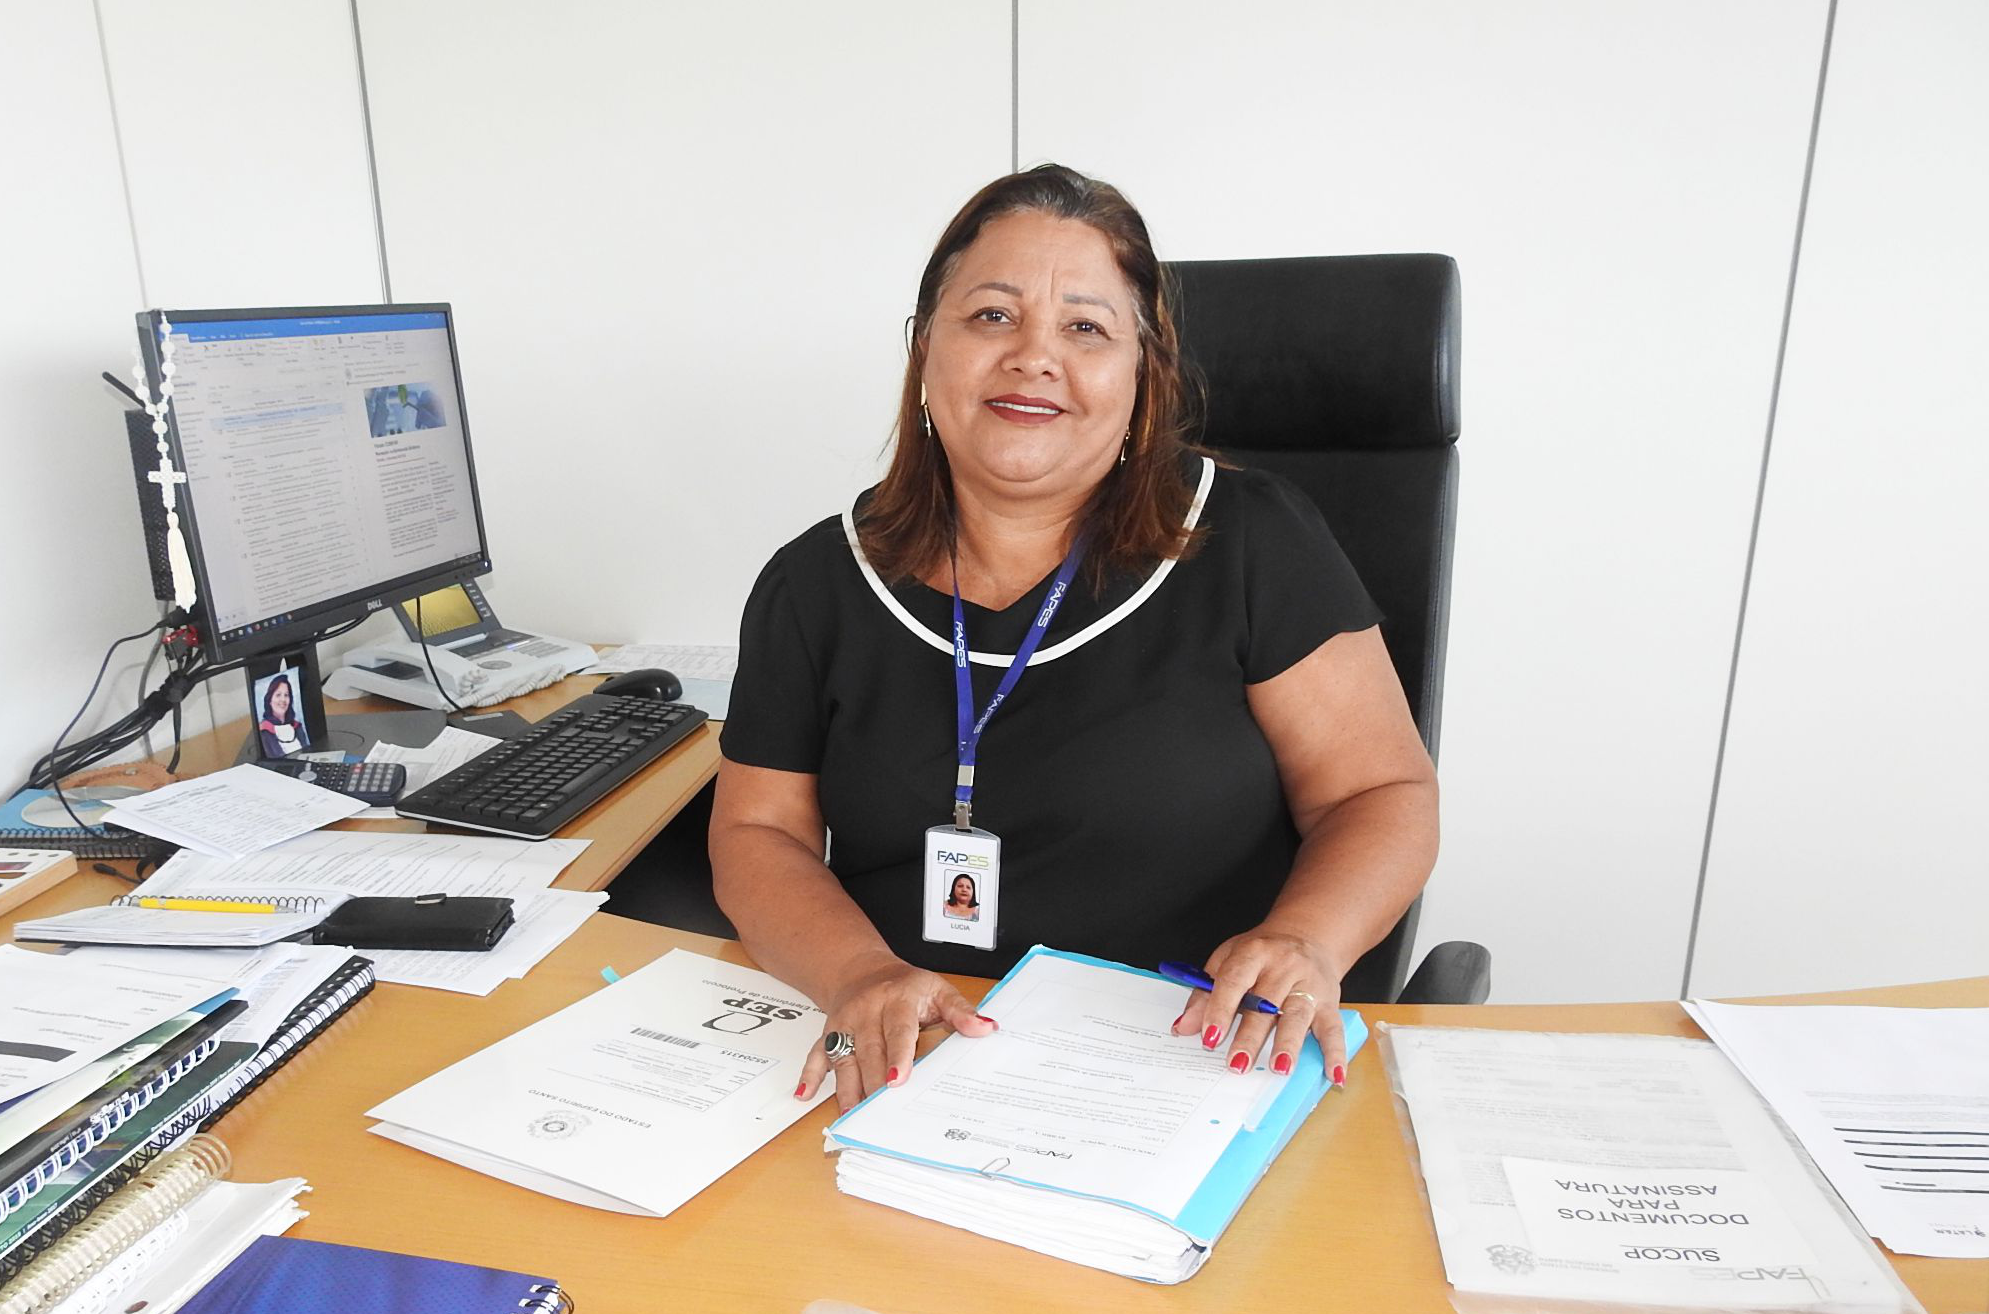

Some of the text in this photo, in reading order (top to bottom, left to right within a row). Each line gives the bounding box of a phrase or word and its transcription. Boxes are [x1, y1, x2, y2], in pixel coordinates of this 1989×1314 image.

[1038, 581, 1067, 628] FAPES
[956, 621, 967, 668] FAPES
[973, 693, 1005, 734] FAPES
[937, 850, 990, 868] FAPES
[722, 997, 803, 1021] SEP
[1014, 1143, 1072, 1160] FAPES
[1554, 1179, 1718, 1197] ASSINATURA
[1606, 1197, 1681, 1210] PARA
[1557, 1207, 1750, 1226] DOCUMENTOS
[1624, 1247, 1721, 1262] SUCOP
